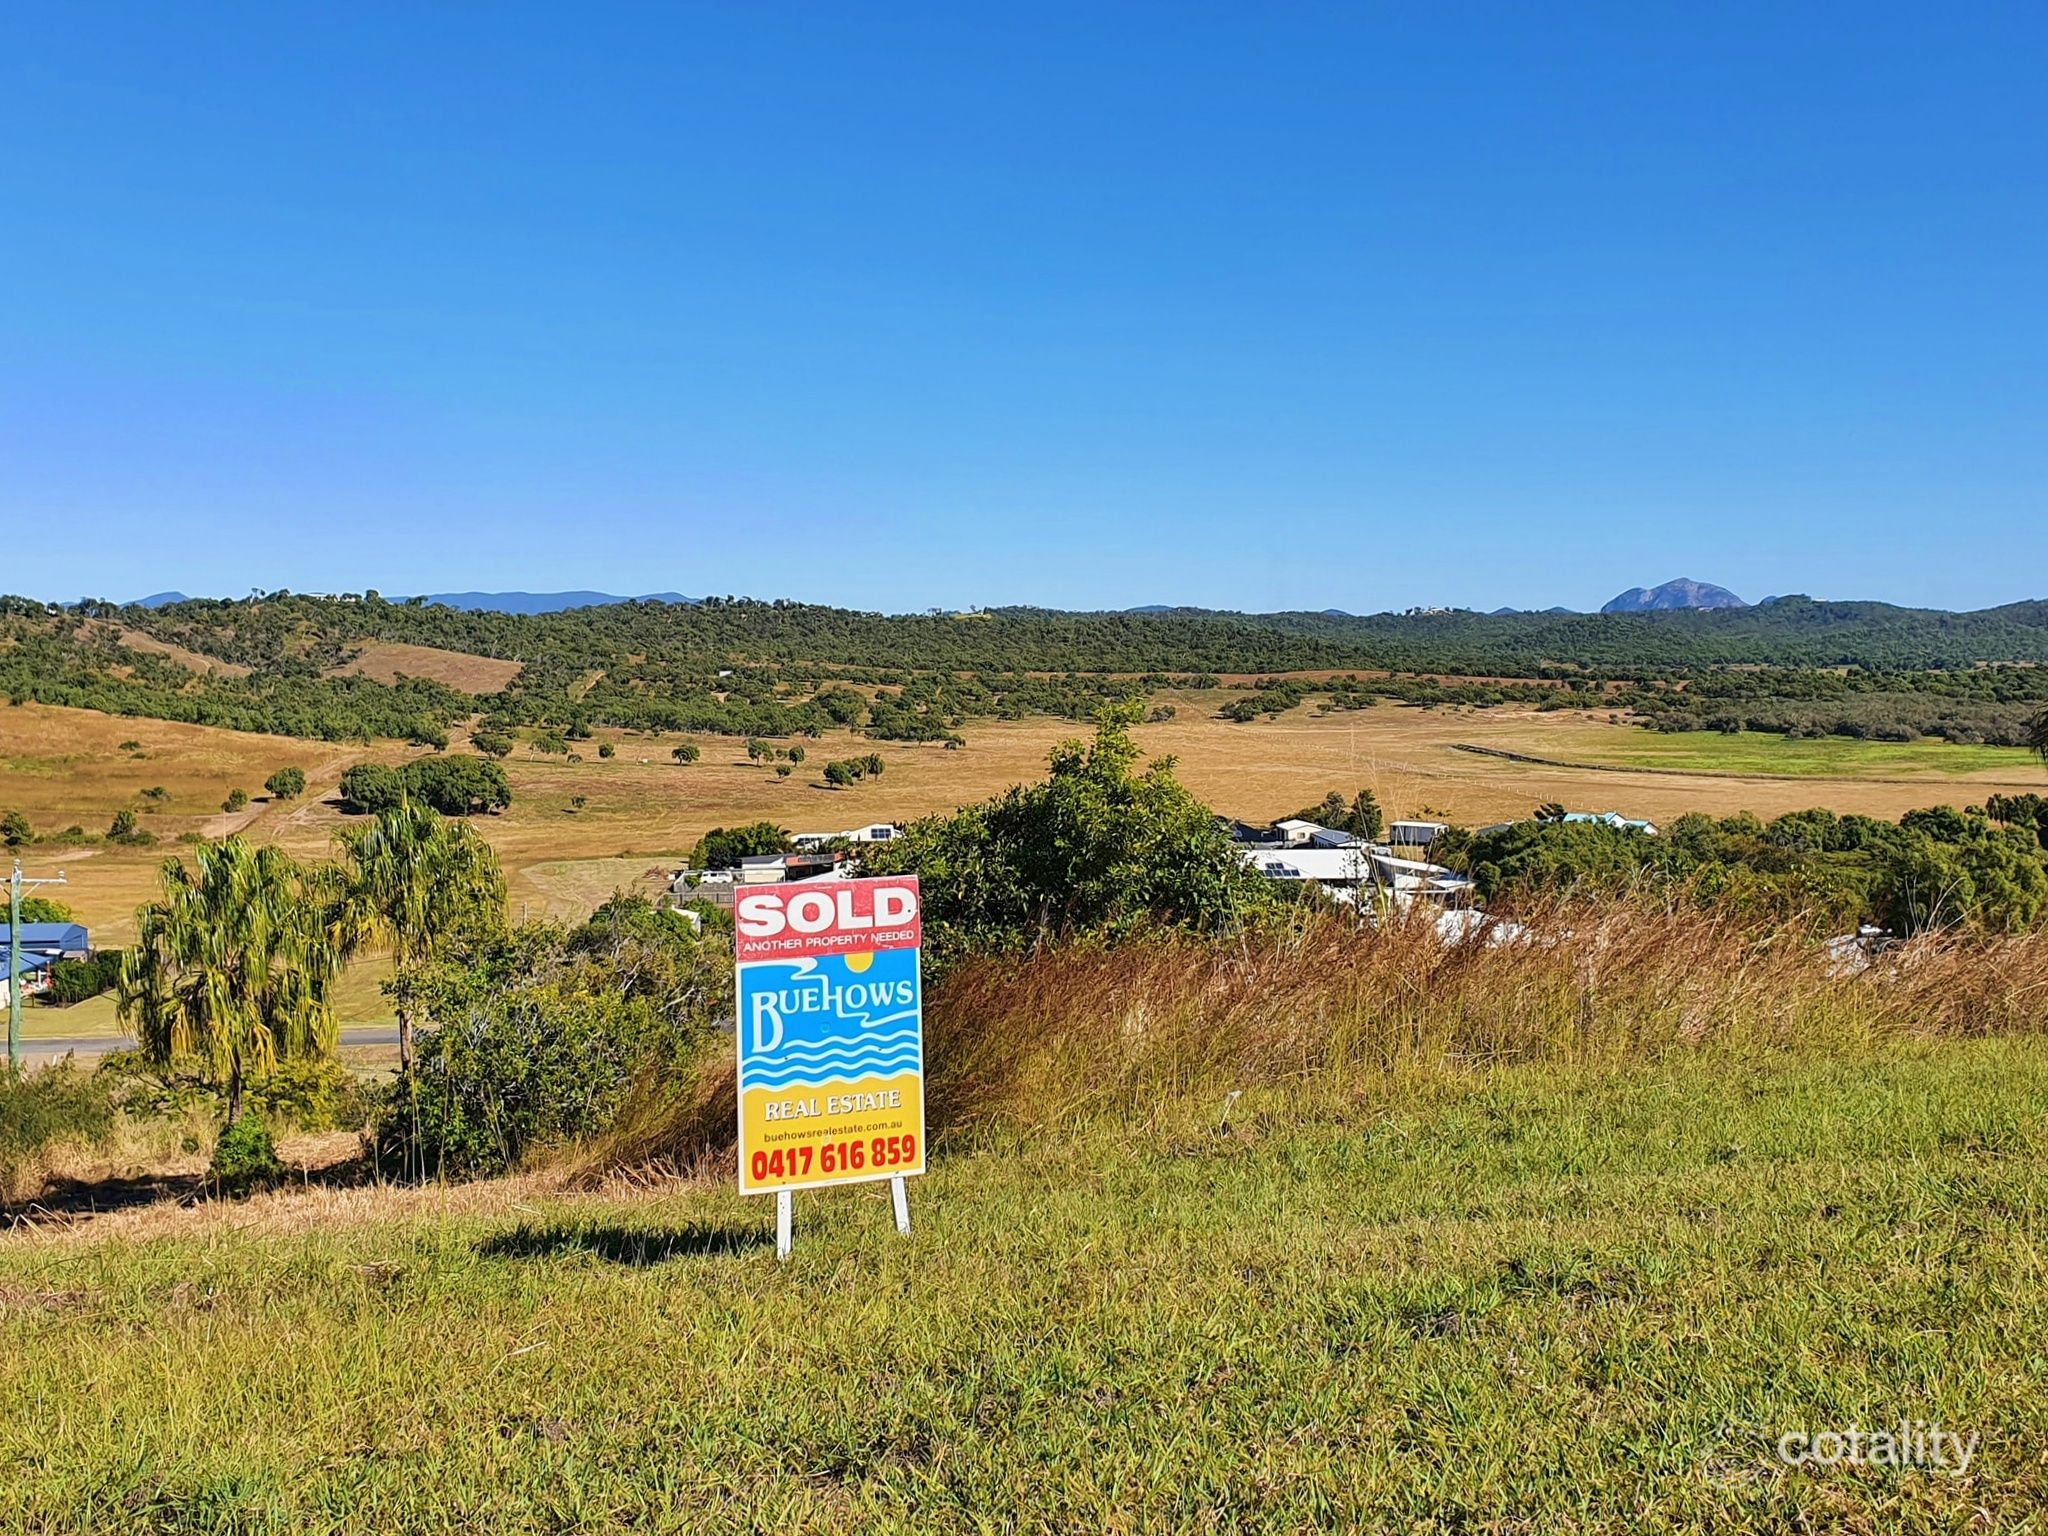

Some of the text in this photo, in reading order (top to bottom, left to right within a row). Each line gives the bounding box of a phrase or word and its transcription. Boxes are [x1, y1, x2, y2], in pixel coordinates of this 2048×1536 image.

[738, 887, 917, 937] SOLD
[743, 930, 915, 952] ANOTHER PROPERTY NEEDED
[764, 1089, 902, 1121] REAL ESTATE
[764, 1121, 903, 1143] buehowsrealestate.com.au
[752, 1134, 916, 1180] 0417 616 859
